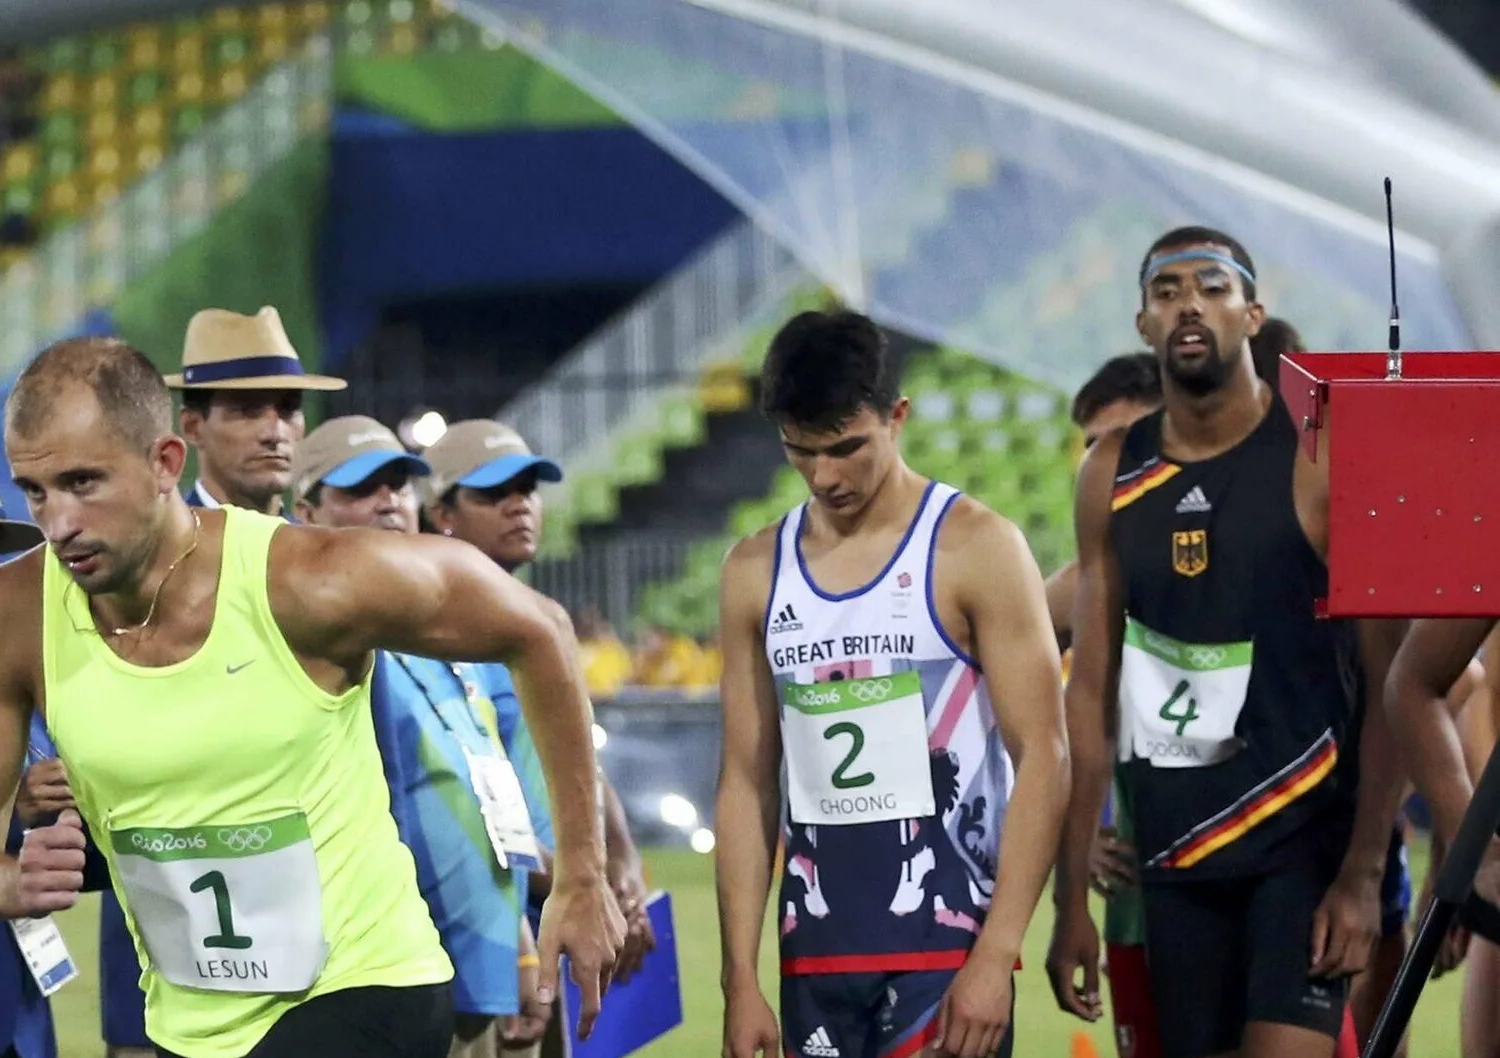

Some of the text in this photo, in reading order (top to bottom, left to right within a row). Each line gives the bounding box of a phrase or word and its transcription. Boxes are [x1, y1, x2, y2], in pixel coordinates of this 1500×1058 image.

[773, 634, 915, 668] GREAT BRITAIN
[1159, 678, 1200, 737] 4
[823, 721, 875, 789] 2
[819, 792, 898, 816] CHOONG
[131, 832, 208, 851] Rio2016
[189, 869, 254, 950] 1
[196, 959, 269, 980] LESUN
